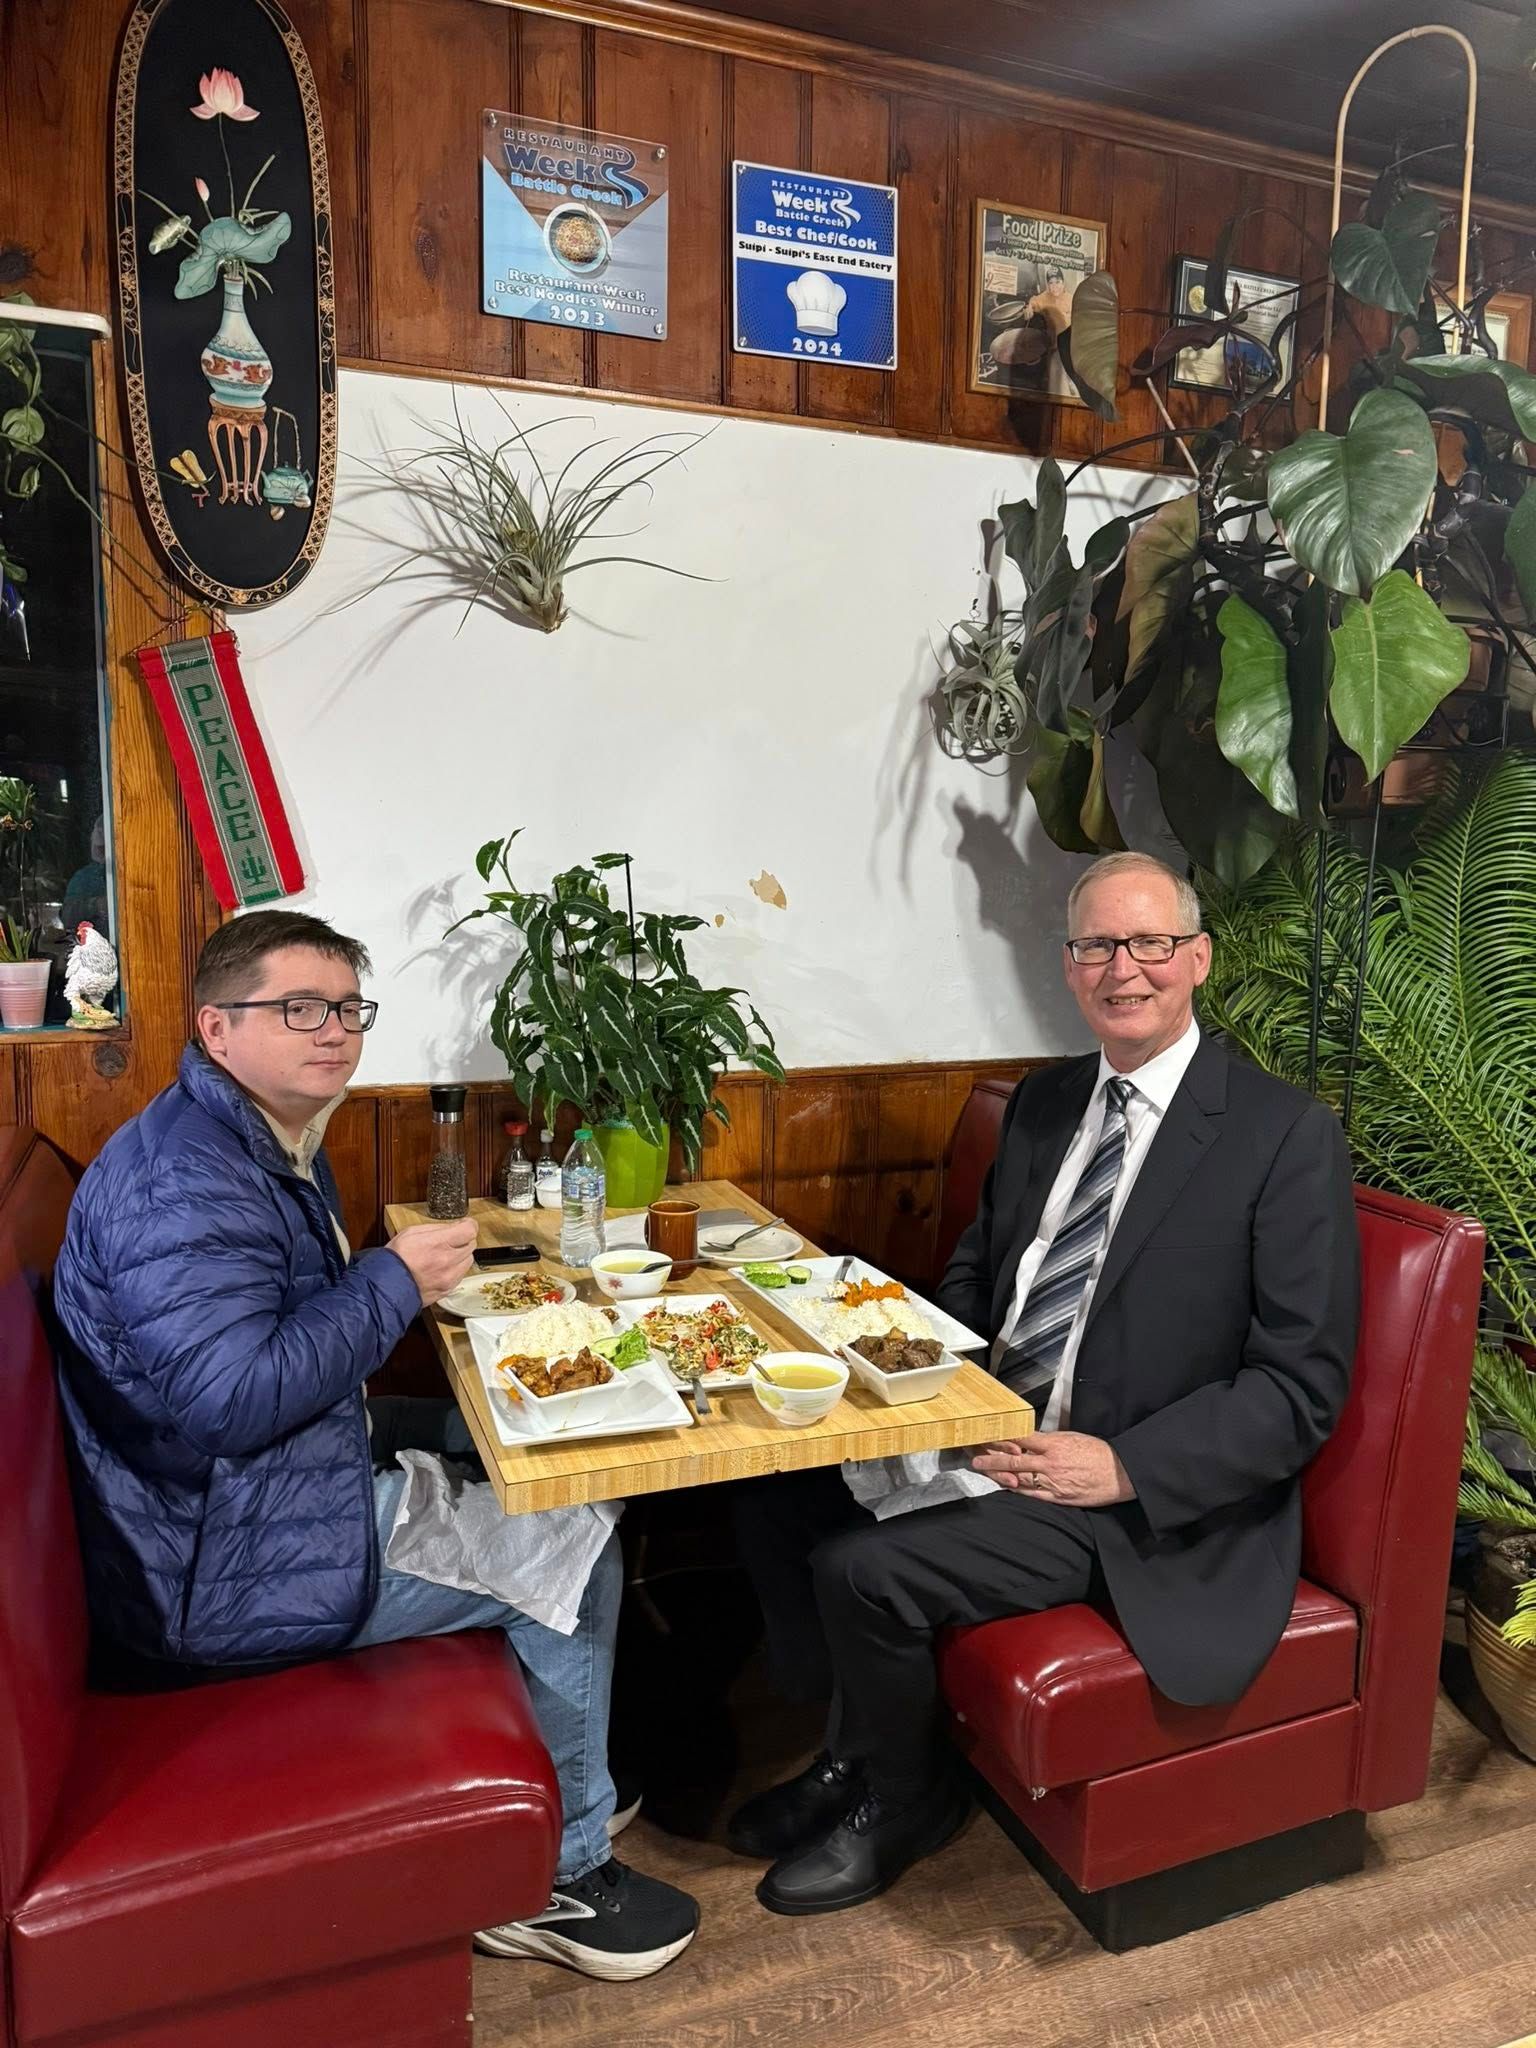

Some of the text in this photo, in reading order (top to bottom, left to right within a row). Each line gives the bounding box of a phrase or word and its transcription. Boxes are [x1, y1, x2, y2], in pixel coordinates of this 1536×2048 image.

[504, 127, 626, 161] RESTAURANT
[504, 143, 598, 183] Week
[510, 172, 623, 207] Battle Creek
[771, 180, 846, 198] RESTAURANT
[771, 190, 828, 214] Week
[776, 208, 845, 228] Battle Creek
[1002, 214, 1082, 248] Food Prize
[755, 220, 877, 251] Best Chef/Cook
[738, 241, 767, 254] Suipi
[775, 246, 811, 260] Suipi's
[813, 252, 835, 264] East
[838, 256, 856, 266] End
[859, 259, 893, 273] Eatery
[494, 280, 660, 318] Best Noodles Winner
[508, 268, 645, 302] Restaurant Week
[550, 305, 606, 327] 2023
[792, 337, 843, 357] 2024
[185, 683, 256, 842] PEACE
